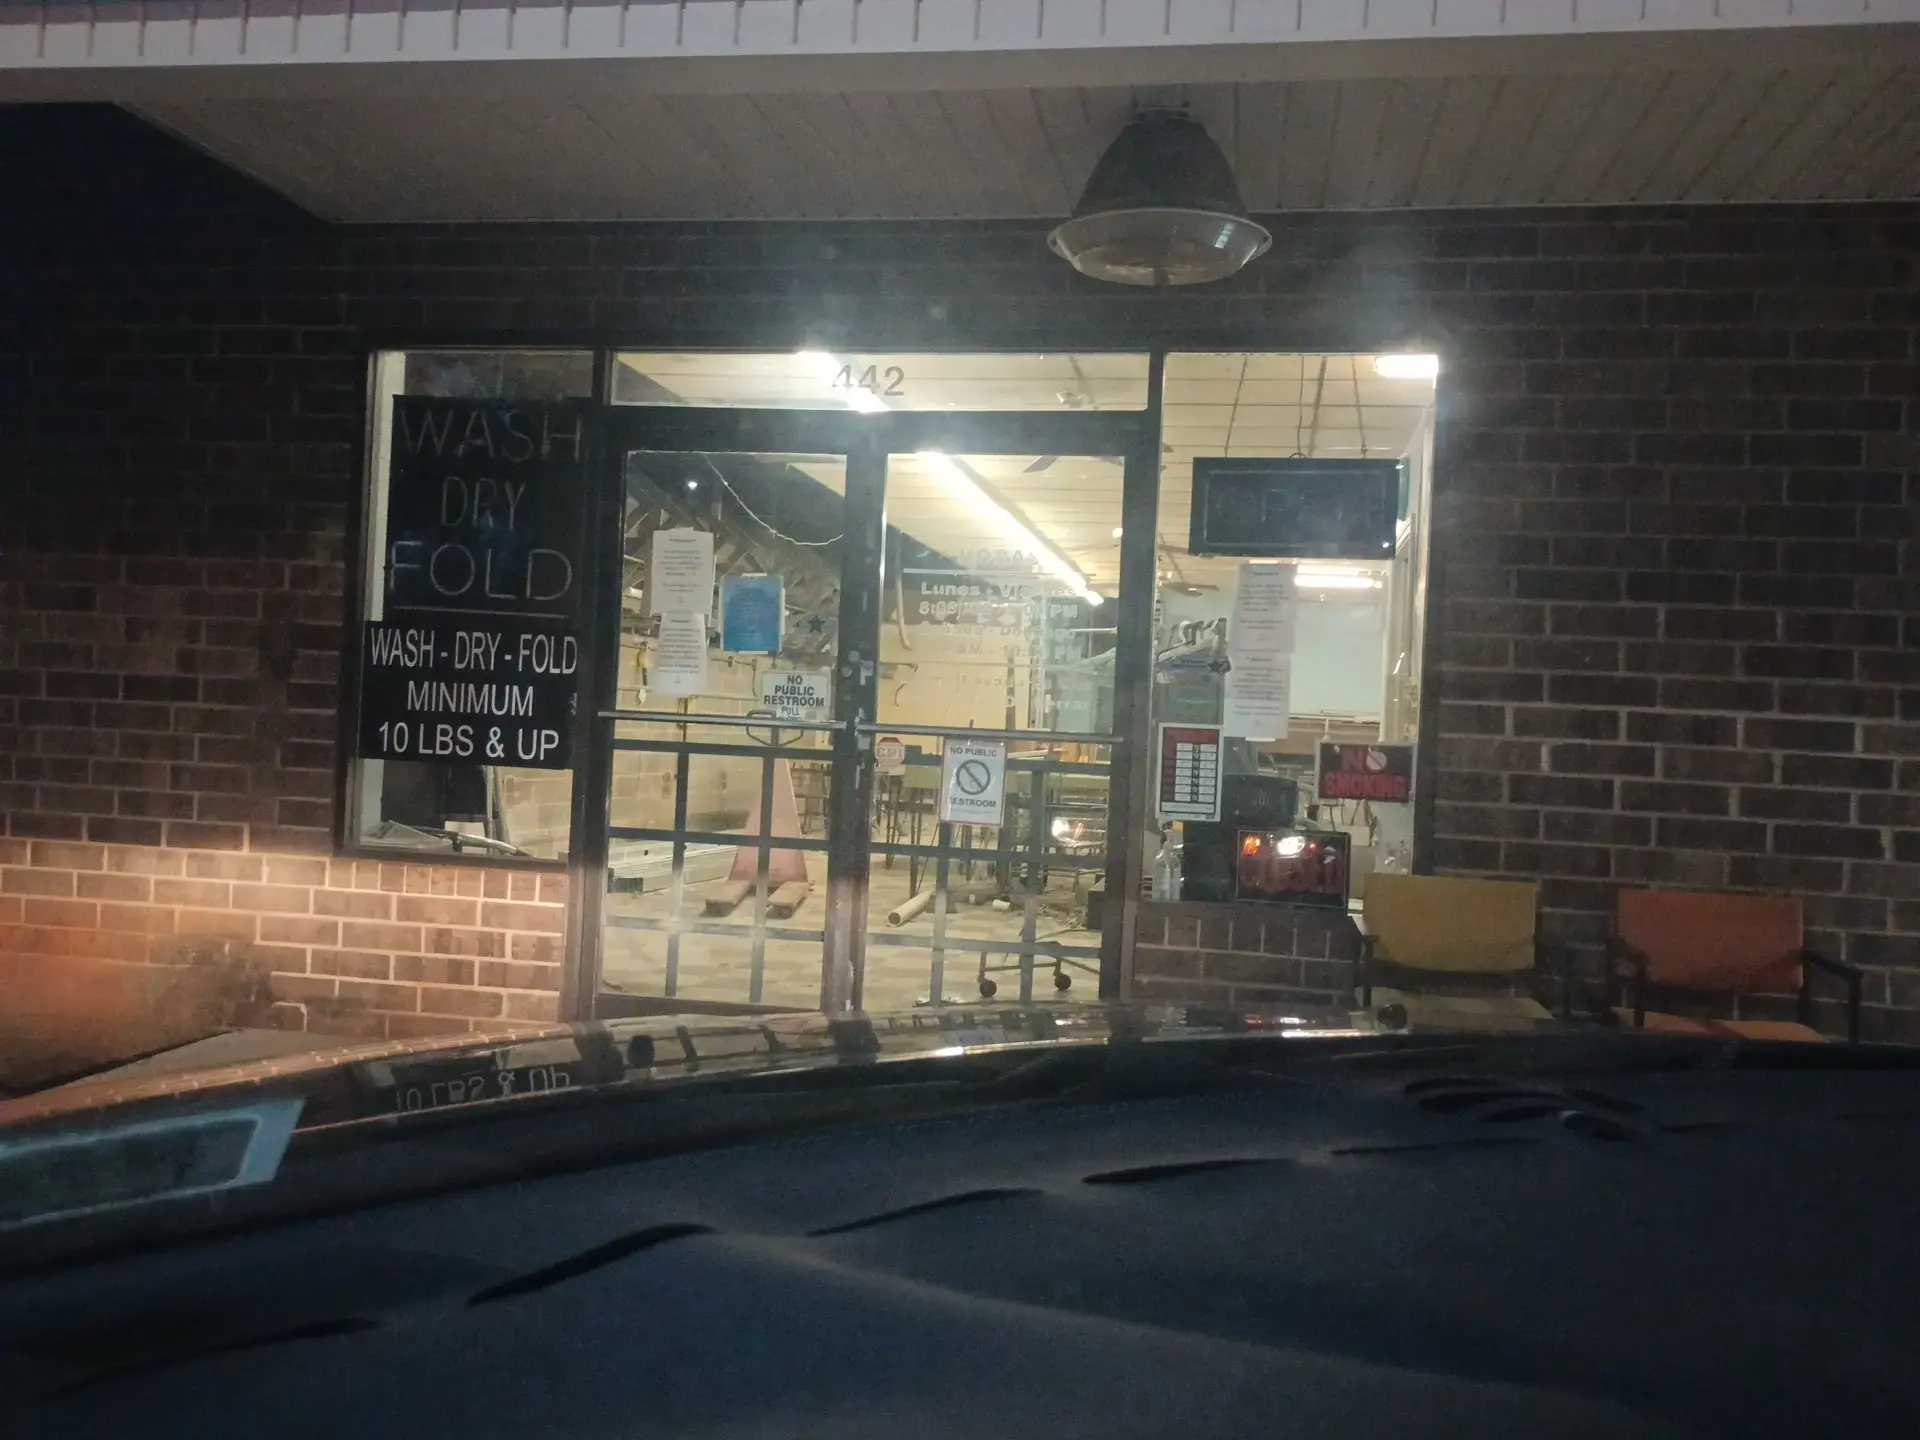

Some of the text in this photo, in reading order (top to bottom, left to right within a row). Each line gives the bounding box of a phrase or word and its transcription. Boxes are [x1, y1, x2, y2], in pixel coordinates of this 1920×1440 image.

[832, 364, 905, 396] 442
[402, 408, 582, 463] WASH
[441, 476, 526, 530] DRY
[390, 540, 571, 600] FOLD
[920, 582, 980, 596] Lunes
[1050, 604, 1078, 618] PM
[371, 628, 435, 668] WASH
[454, 631, 502, 671] DRY
[518, 633, 578, 674] FOLD
[774, 685, 815, 696] PUBLIC
[787, 675, 803, 685] NO
[406, 680, 534, 717] MINIMUM
[763, 695, 824, 707] RESTROOM
[781, 706, 800, 716] PULL
[379, 721, 560, 761] 10 LBS & UP
[950, 746, 997, 757] NO PUBLIC
[1324, 771, 1408, 799] SMOKING
